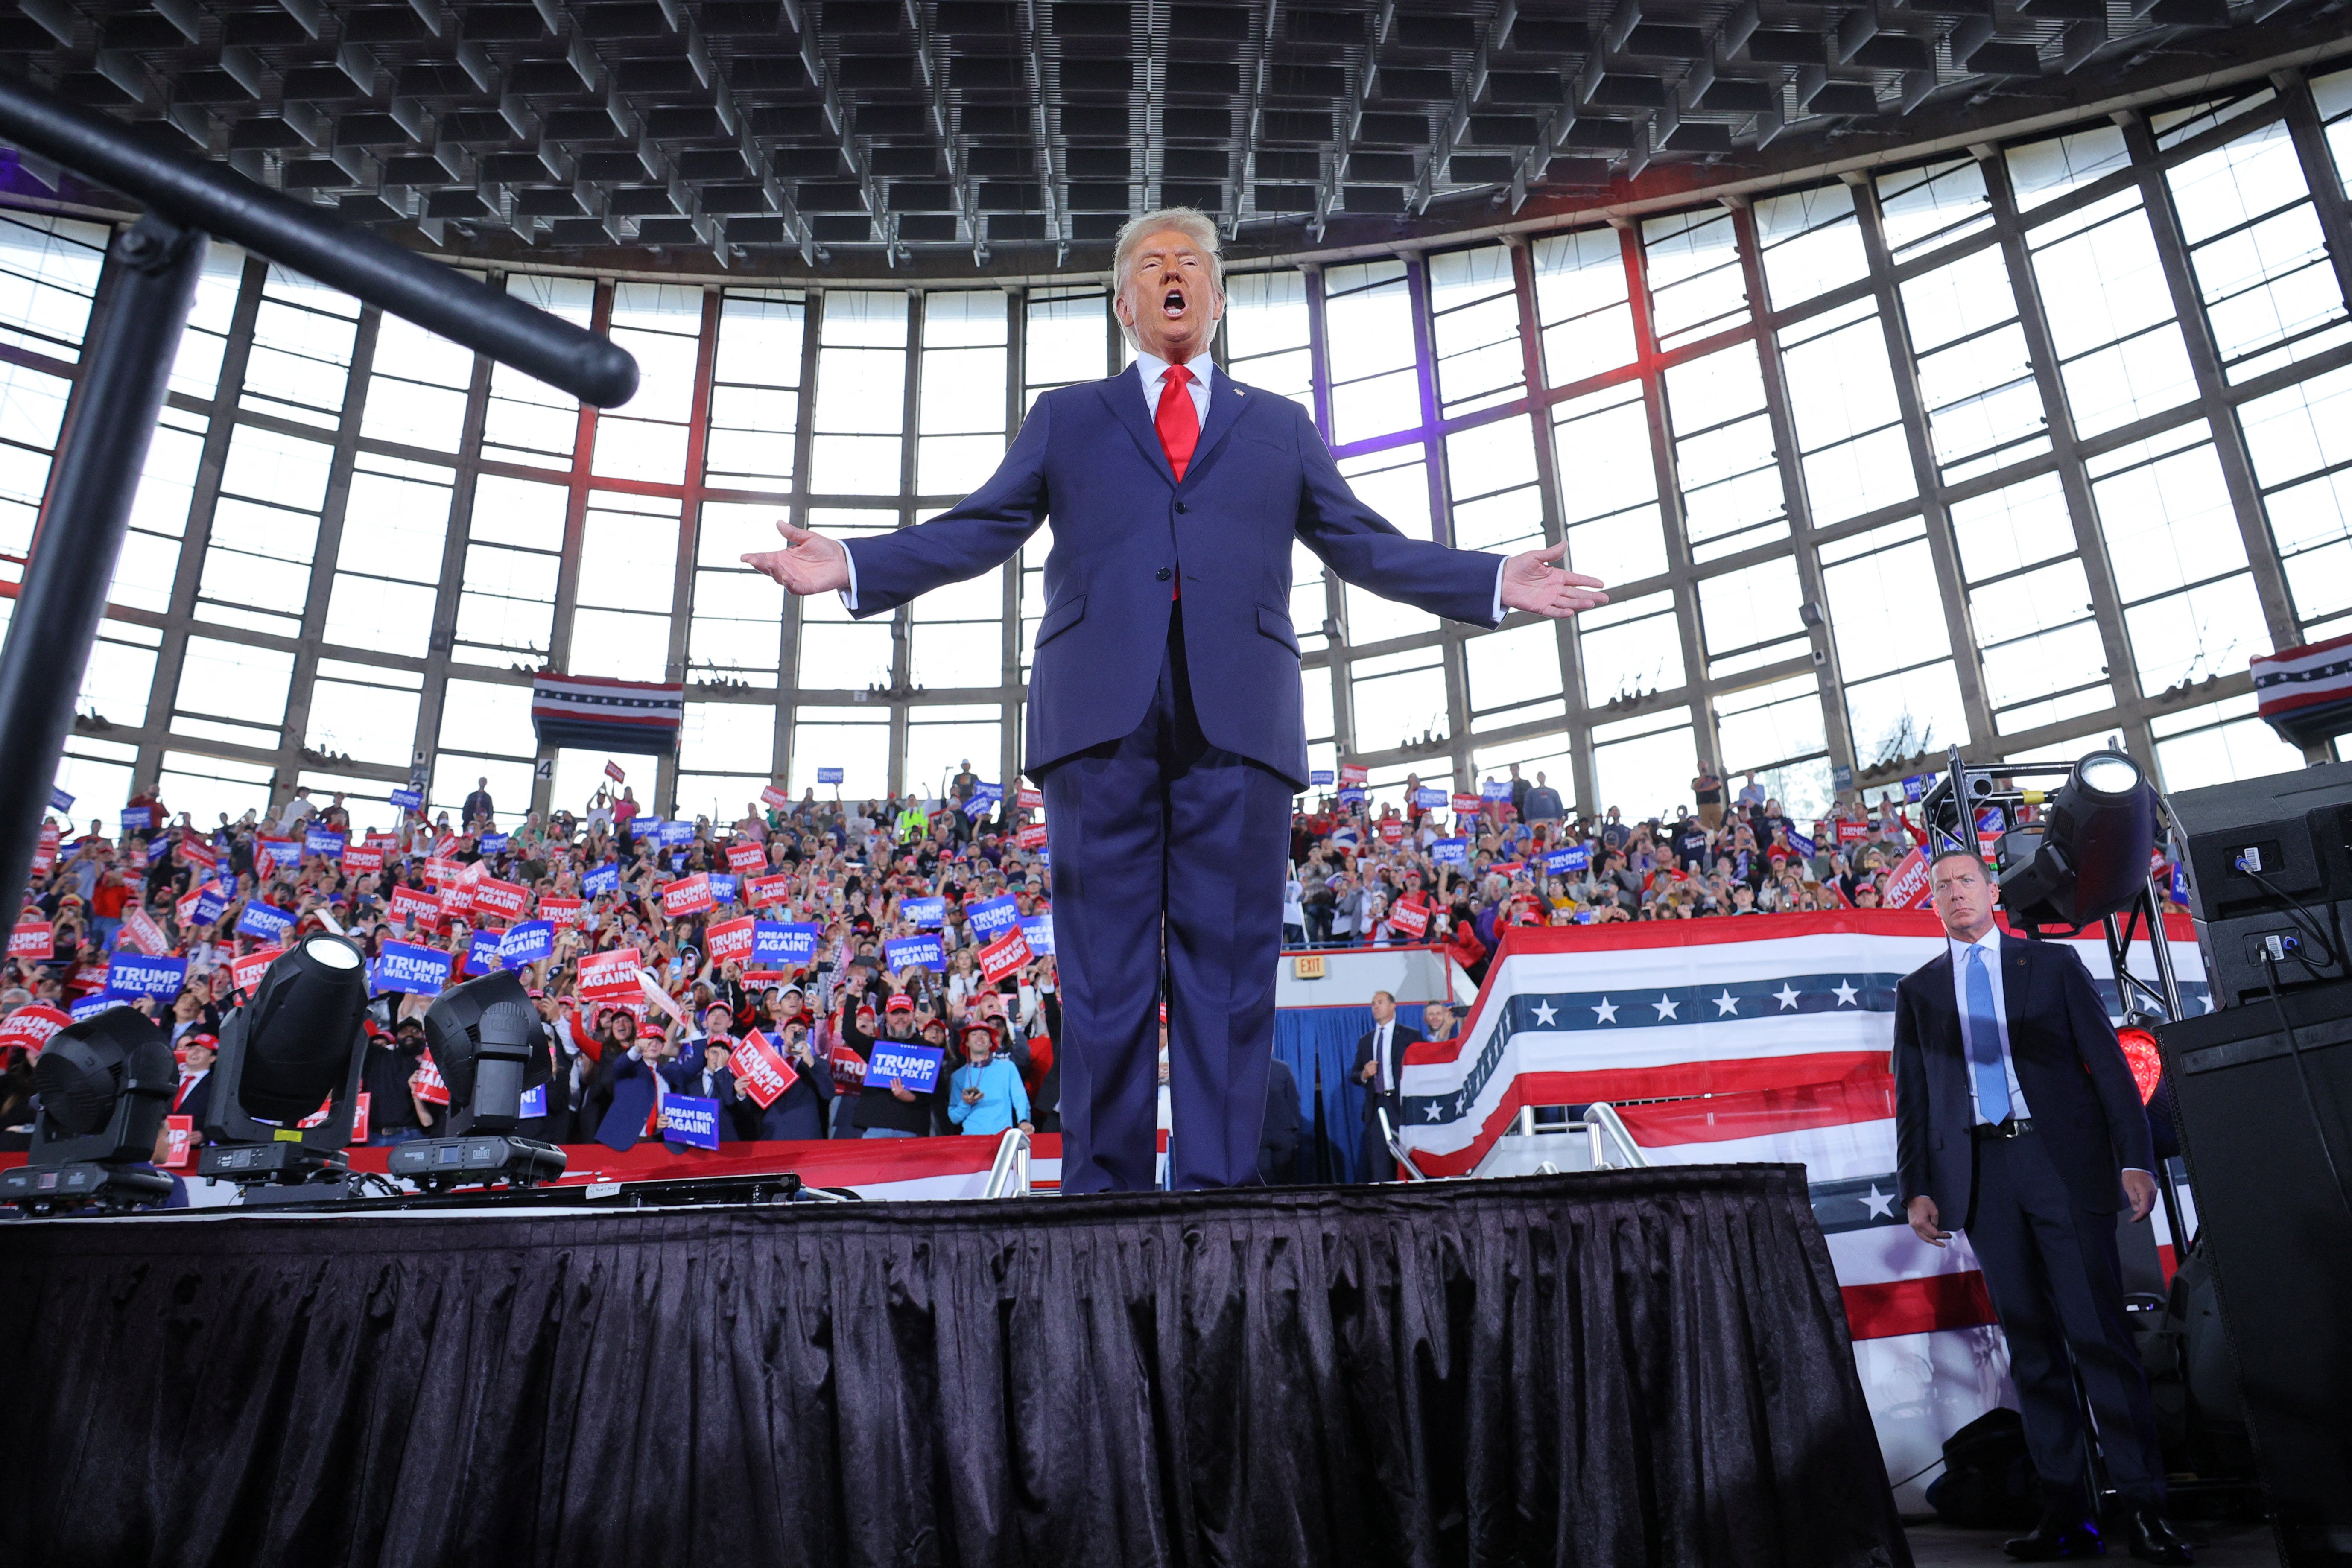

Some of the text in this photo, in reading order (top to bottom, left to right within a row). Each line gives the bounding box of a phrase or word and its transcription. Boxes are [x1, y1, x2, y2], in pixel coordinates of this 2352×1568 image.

[538, 761, 552, 778] 4
[660, 826, 691, 837] TRUMP
[345, 852, 381, 862] TRUMP
[733, 855, 762, 867] AGAIN!
[584, 870, 616, 888] TRUMP
[710, 882, 733, 893] UMP
[440, 888, 472, 901] TRUM
[477, 885, 507, 896] DREAM
[666, 881, 707, 901] TRUMP
[762, 887, 785, 899] GAIN!
[395, 896, 439, 914] TRUMP
[475, 893, 518, 910] AGAIN!
[903, 905, 943, 914] TUMP
[247, 908, 291, 927] TRUMP
[428, 913, 436, 921] IT
[542, 906, 578, 917] TRUM
[970, 904, 1015, 925] TRUMP
[974, 914, 1016, 932] WILL FIX IT
[529, 928, 550, 939] BIG,
[710, 928, 752, 949] TRUMP
[757, 931, 814, 943] DREAM BIG,
[1026, 934, 1054, 944] AGA
[474, 942, 501, 954] DREA
[497, 936, 545, 958] AGAIN!
[712, 938, 753, 957] WILL FIX IT
[757, 939, 809, 952] AGAIN!
[889, 942, 941, 958] DREAM BIG,
[983, 943, 1012, 966] DREAM
[385, 954, 447, 976] TRUMP
[580, 959, 638, 977] DREAM BIG,
[892, 950, 938, 968] AGAIN!
[988, 943, 1026, 975] AGAIN!
[1300, 958, 1320, 973] EXIT
[113, 965, 182, 984] TRUMP
[237, 961, 268, 981] TRU
[384, 966, 445, 985] WILL FIX IT
[581, 970, 636, 989] AGAIN!
[111, 979, 178, 994] WILL FIX IT
[24, 1028, 44, 1041] FIX
[741, 1039, 785, 1088] TRUMP
[833, 1058, 868, 1076] TRU
[874, 1053, 936, 1072] TRUMP
[735, 1050, 776, 1095] WILL FIX IT
[872, 1066, 933, 1081] WILL FIX IT
[665, 1106, 715, 1124] DREAM BIG,
[667, 1117, 711, 1135] AGAIN!
[172, 1143, 185, 1153] IT
